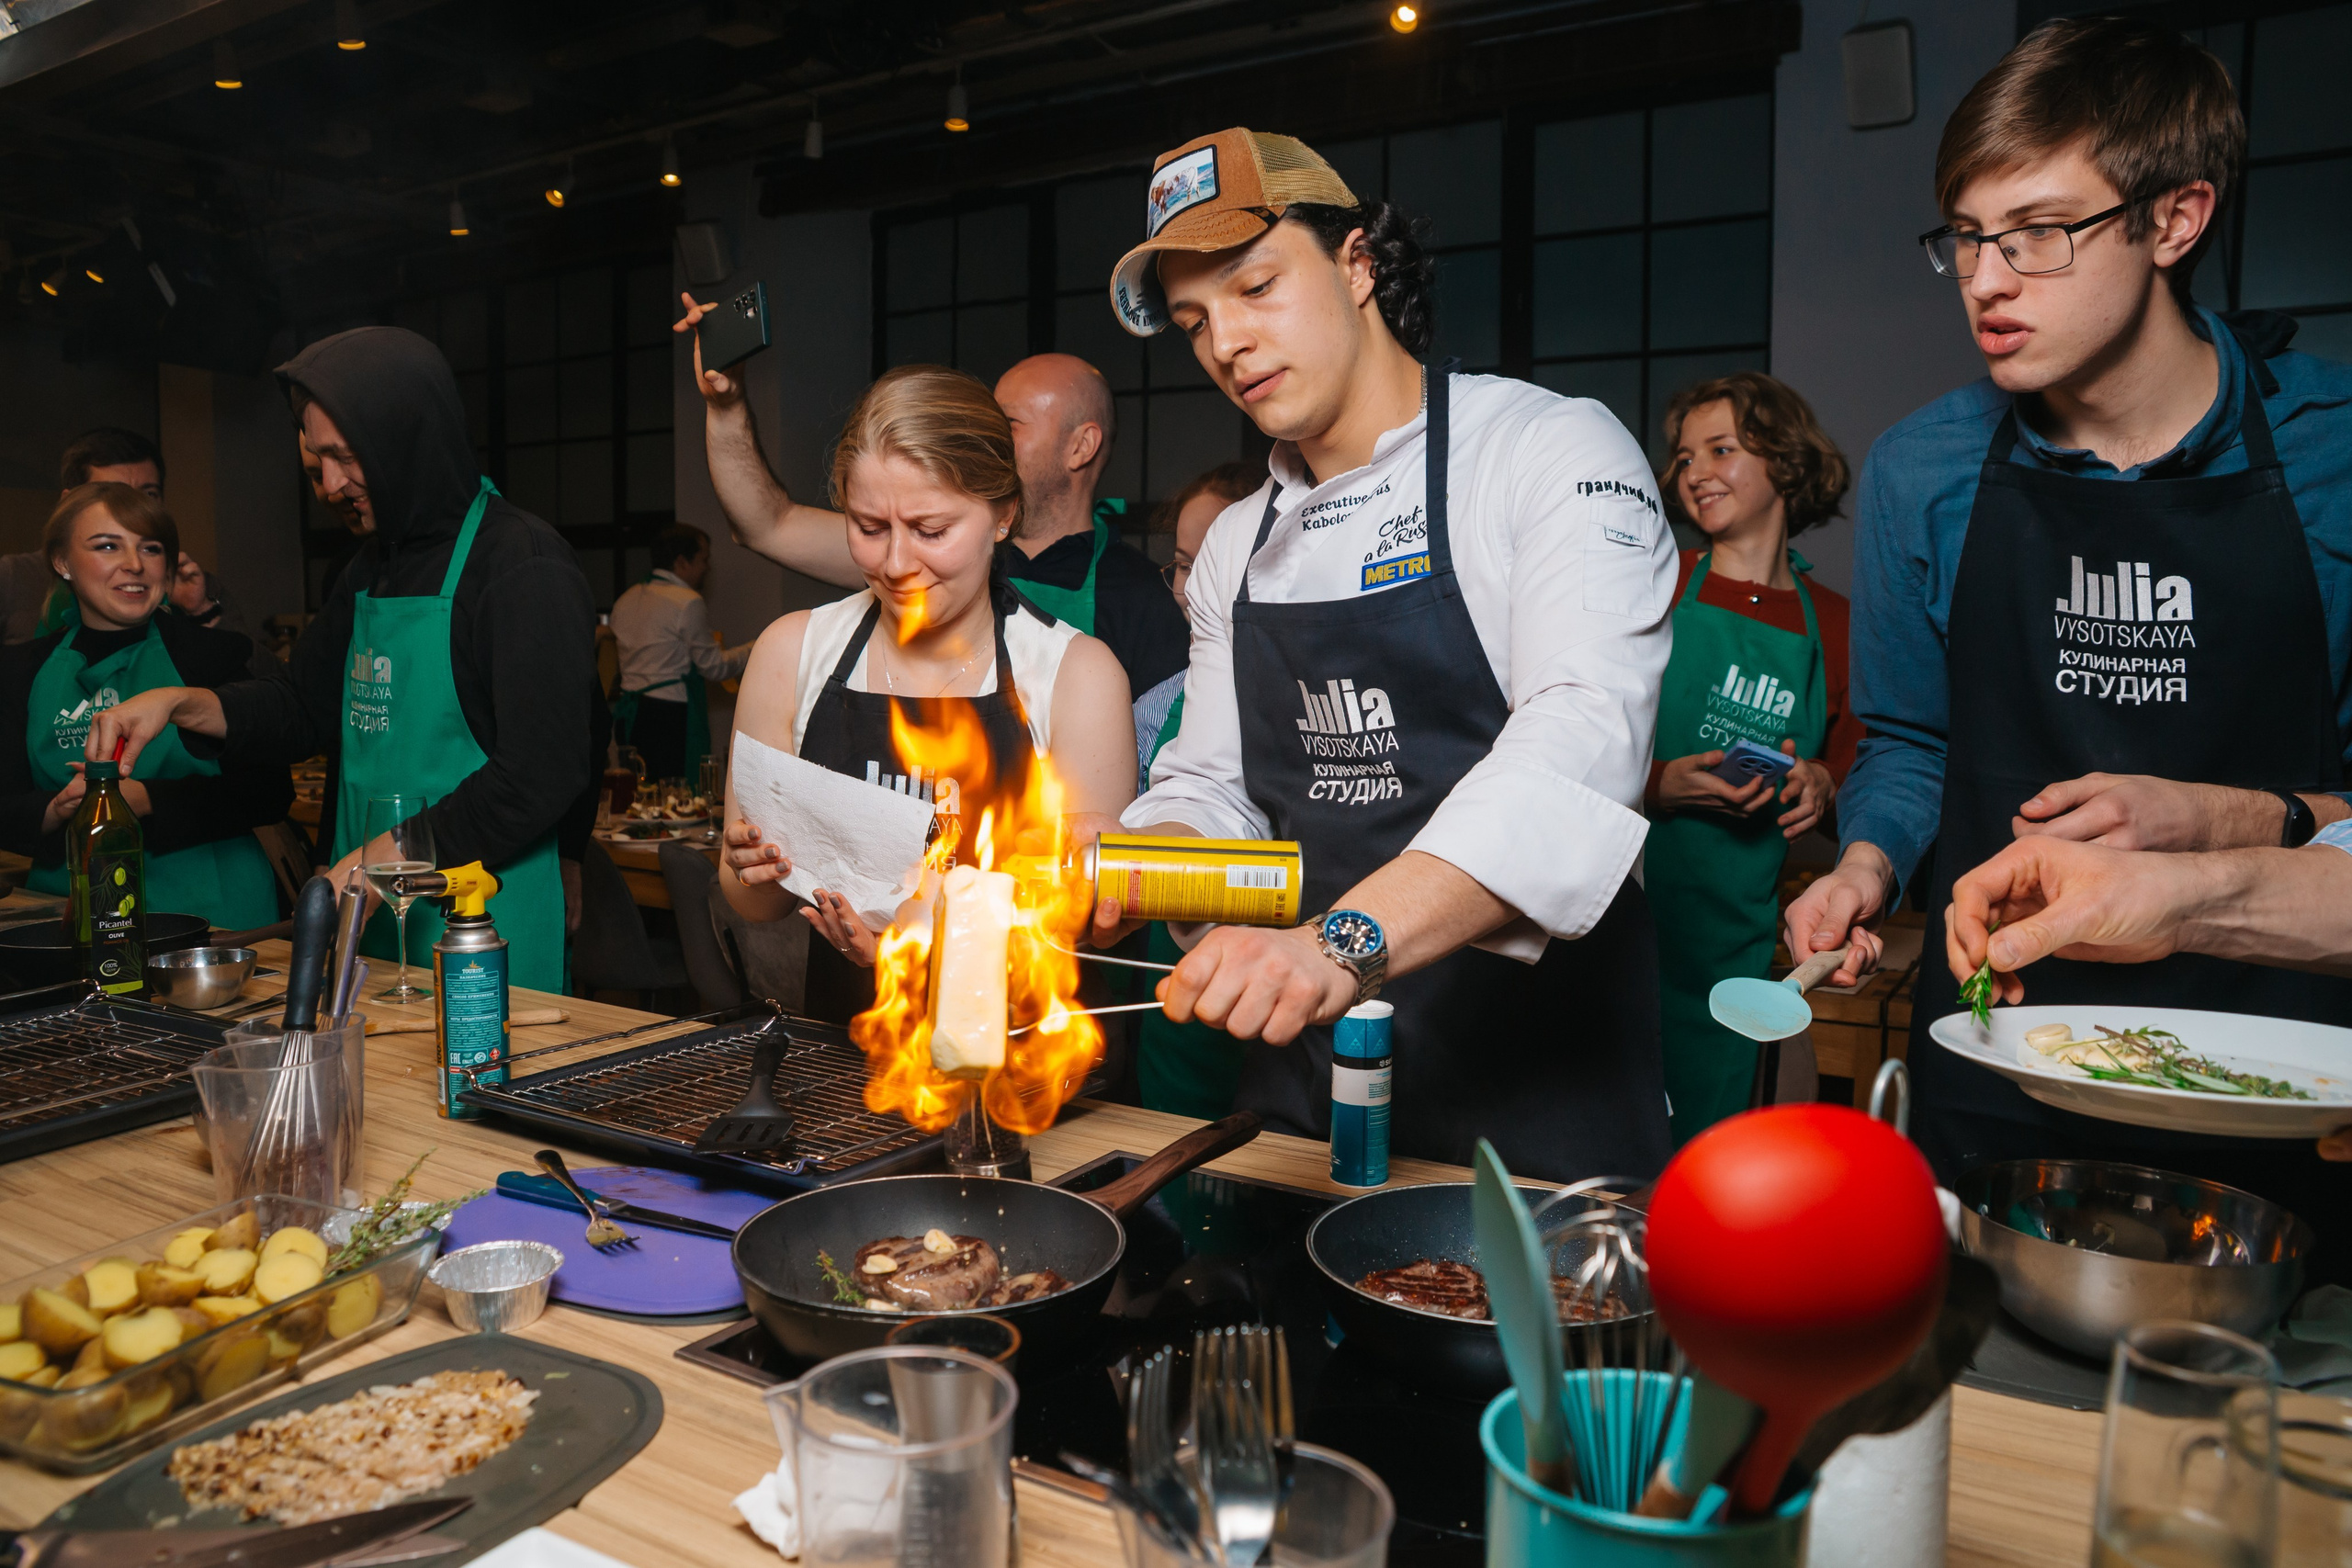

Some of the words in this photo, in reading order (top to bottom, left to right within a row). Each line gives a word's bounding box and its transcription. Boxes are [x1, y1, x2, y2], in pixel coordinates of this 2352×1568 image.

[1119, 287, 1140, 326] BROTHERS
[1302, 495, 1368, 517] Executive
[1302, 511, 1354, 531] Kabolo
[1379, 505, 1423, 537] Chef
[1377, 539, 1393, 558] la
[1393, 519, 1427, 547] Rus
[2056, 555, 2194, 621] Julia
[2054, 615, 2196, 648] VYSOTSKAYA
[2059, 649, 2186, 673] КУЛИНАРНАЯ
[1712, 664, 1795, 717] Julia
[2055, 669, 2188, 705] СТУДИЯ
[1296, 679, 1396, 734] Julia
[1707, 694, 1787, 733] VYSOTSKAYA
[349, 711, 390, 733] СТУДИЯ
[1699, 724, 1748, 746] СТУ
[1705, 713, 1776, 744] КУЛИНАРНАЯ
[58, 736, 87, 749] СТУ
[1301, 730, 1400, 758] VYSOTSKAYA
[1313, 761, 1396, 776] КУЛИНАРНАЯ
[1308, 777, 1403, 805] СТУДИЯ
[99, 919, 132, 929] Picantel
